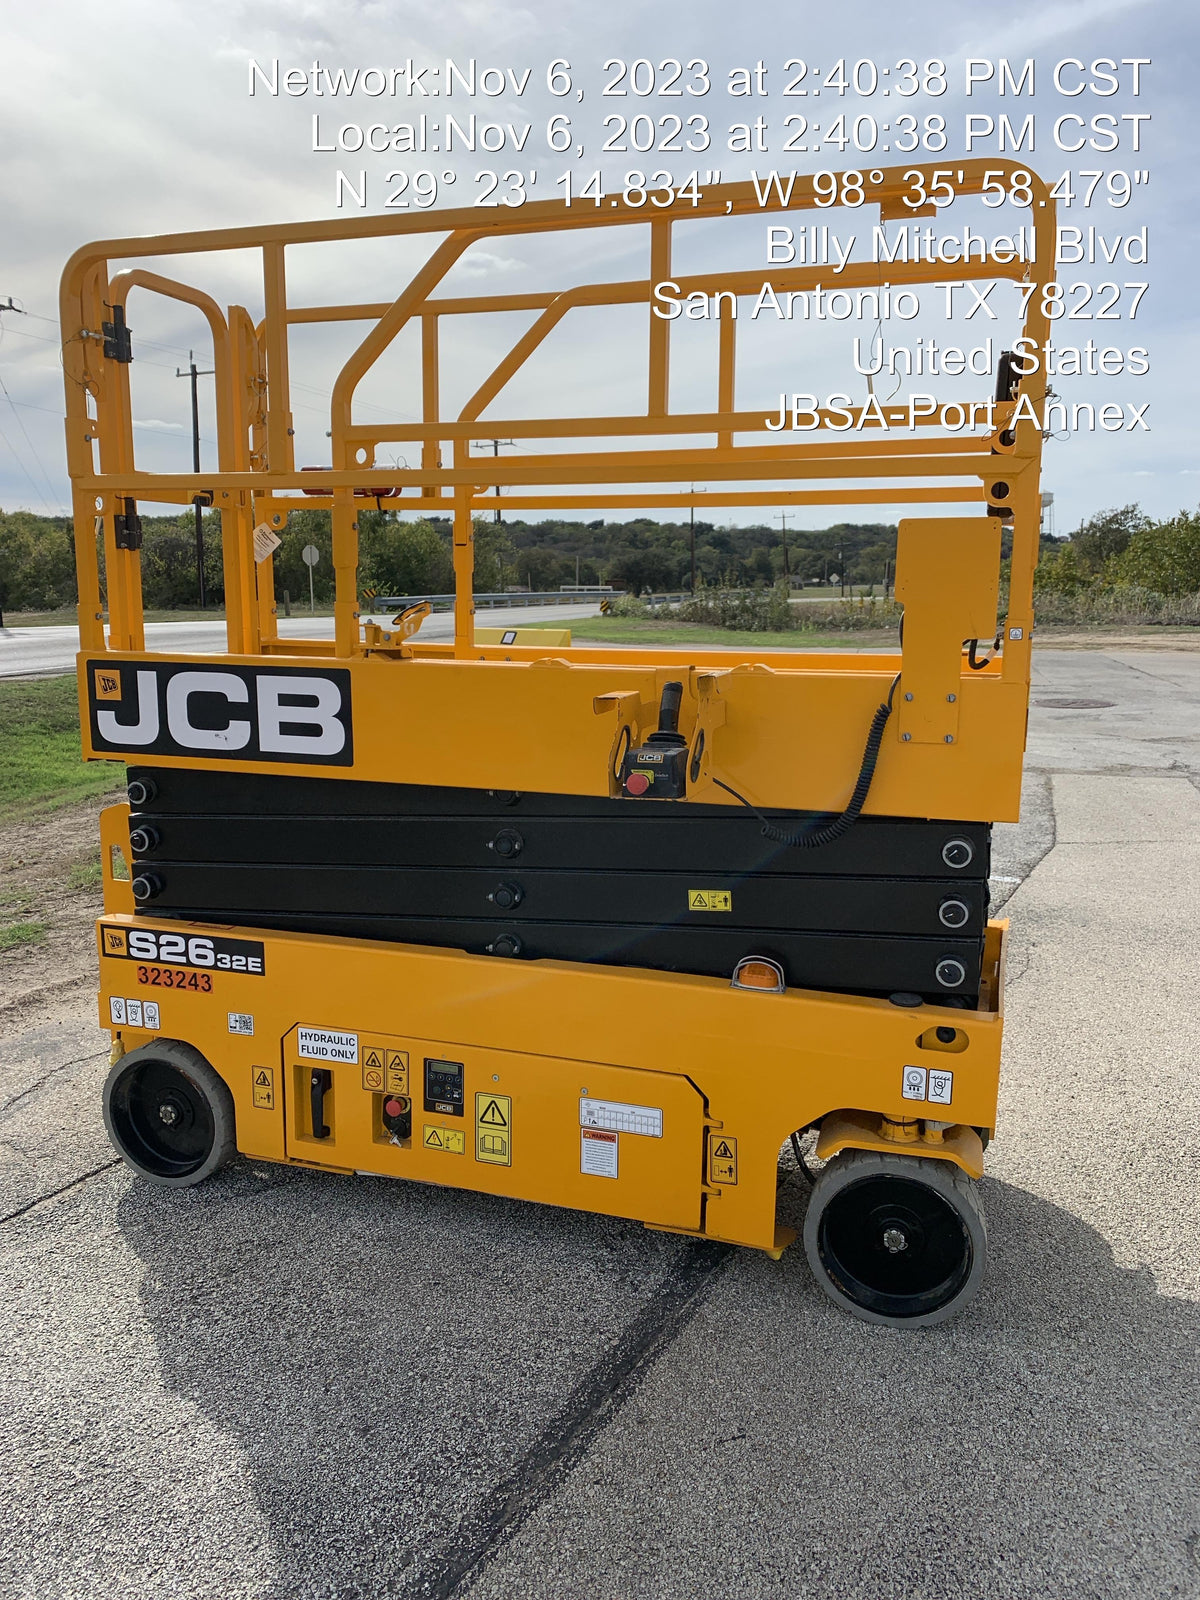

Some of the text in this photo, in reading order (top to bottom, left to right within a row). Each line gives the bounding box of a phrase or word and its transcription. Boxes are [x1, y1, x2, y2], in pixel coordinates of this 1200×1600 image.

[100, 676, 118, 692] JCB
[97, 670, 346, 756] JCB
[107, 934, 124, 949] JCB
[128, 930, 262, 972] S26 32E
[138, 966, 212, 992] 323243
[300, 1031, 356, 1047] HYDRAULIC
[301, 1044, 356, 1060] FLUID ONLY
[591, 1133, 615, 1142] WARNING
